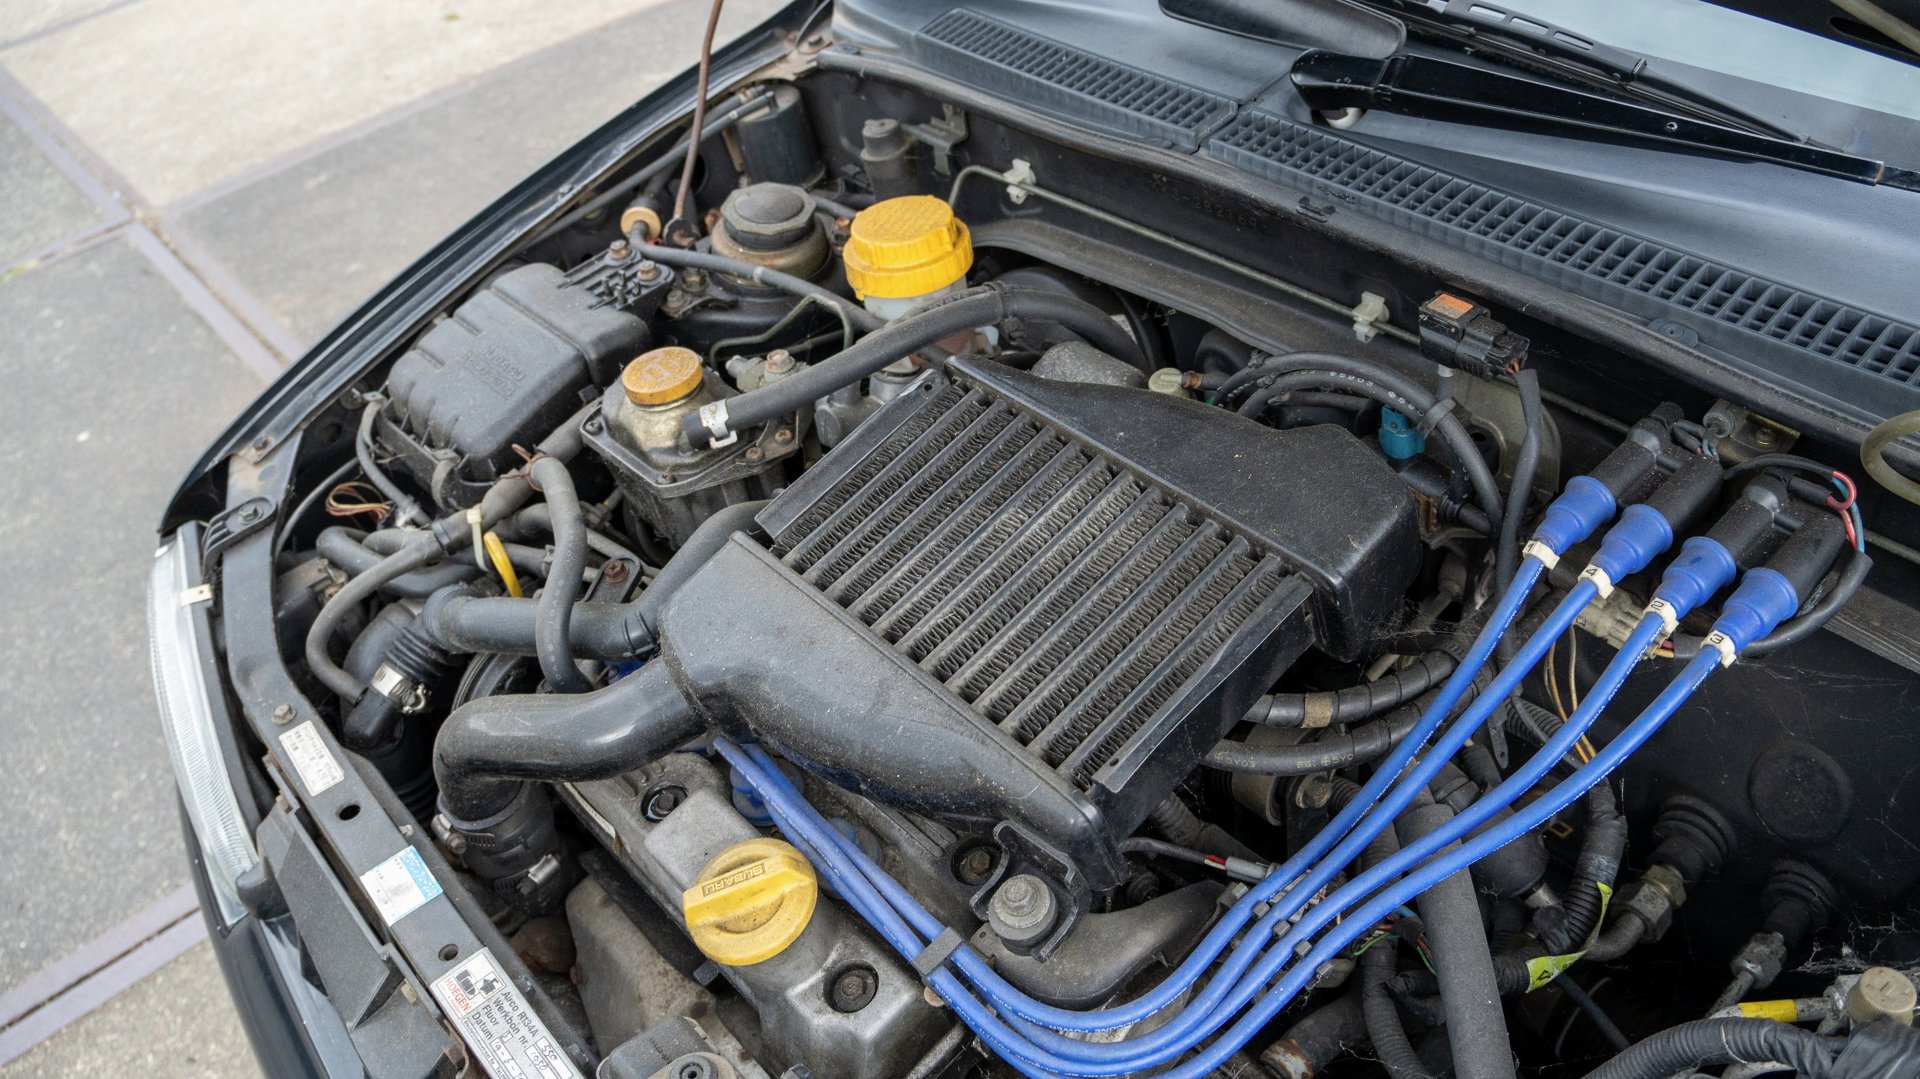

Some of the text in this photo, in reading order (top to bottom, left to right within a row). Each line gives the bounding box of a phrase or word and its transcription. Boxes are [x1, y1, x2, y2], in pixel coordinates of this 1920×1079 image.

[1527, 543, 1534, 552] 1
[1586, 568, 1597, 576] 4
[1651, 600, 1664, 610] 2
[1710, 633, 1724, 645] 3
[704, 865, 763, 894] SUBARU
[481, 1004, 500, 1027] Fluor
[491, 996, 530, 1048] Werkbon nr.
[501, 987, 540, 1037] Airco R134A
[471, 1011, 494, 1040] Datum
